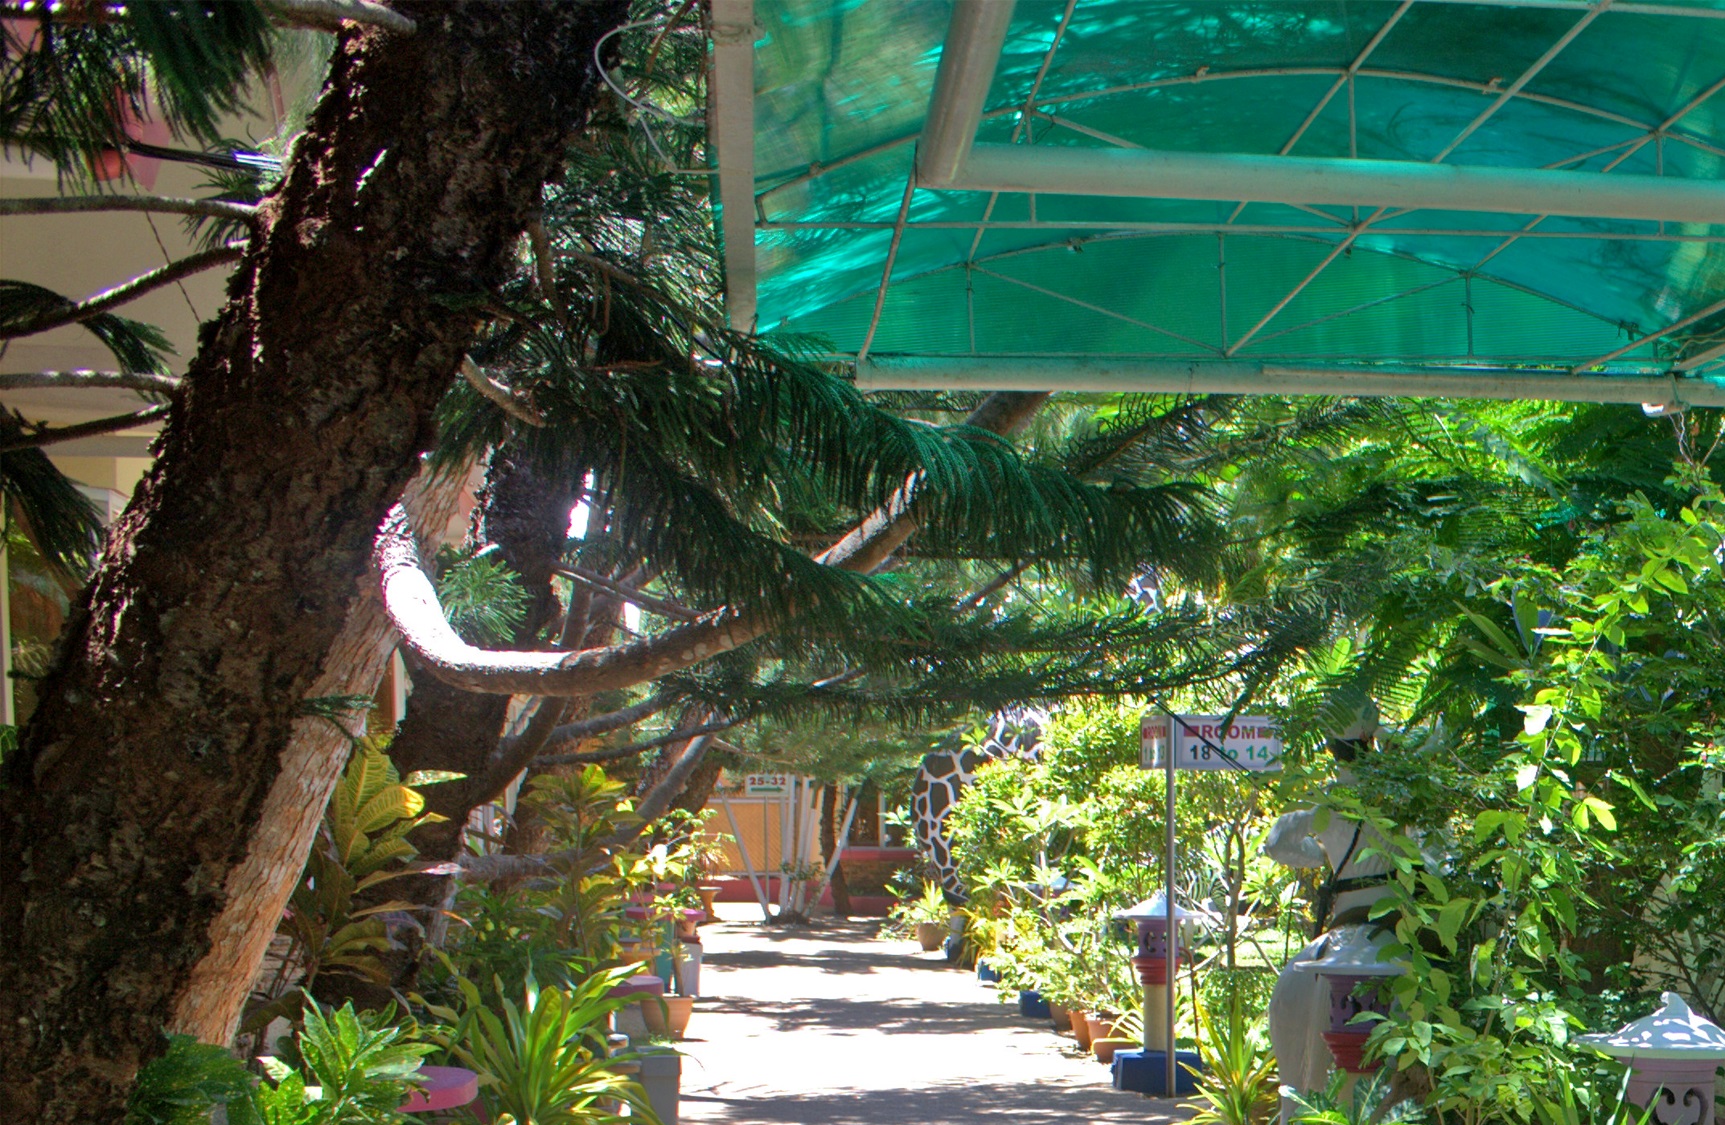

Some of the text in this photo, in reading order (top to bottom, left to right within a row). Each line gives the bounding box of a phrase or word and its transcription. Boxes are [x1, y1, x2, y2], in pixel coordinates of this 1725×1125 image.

[1201, 724, 1256, 739] ROOM
[1189, 744, 1211, 760] 18
[1246, 745, 1268, 760] 14
[749, 776, 786, 786] 25-32
